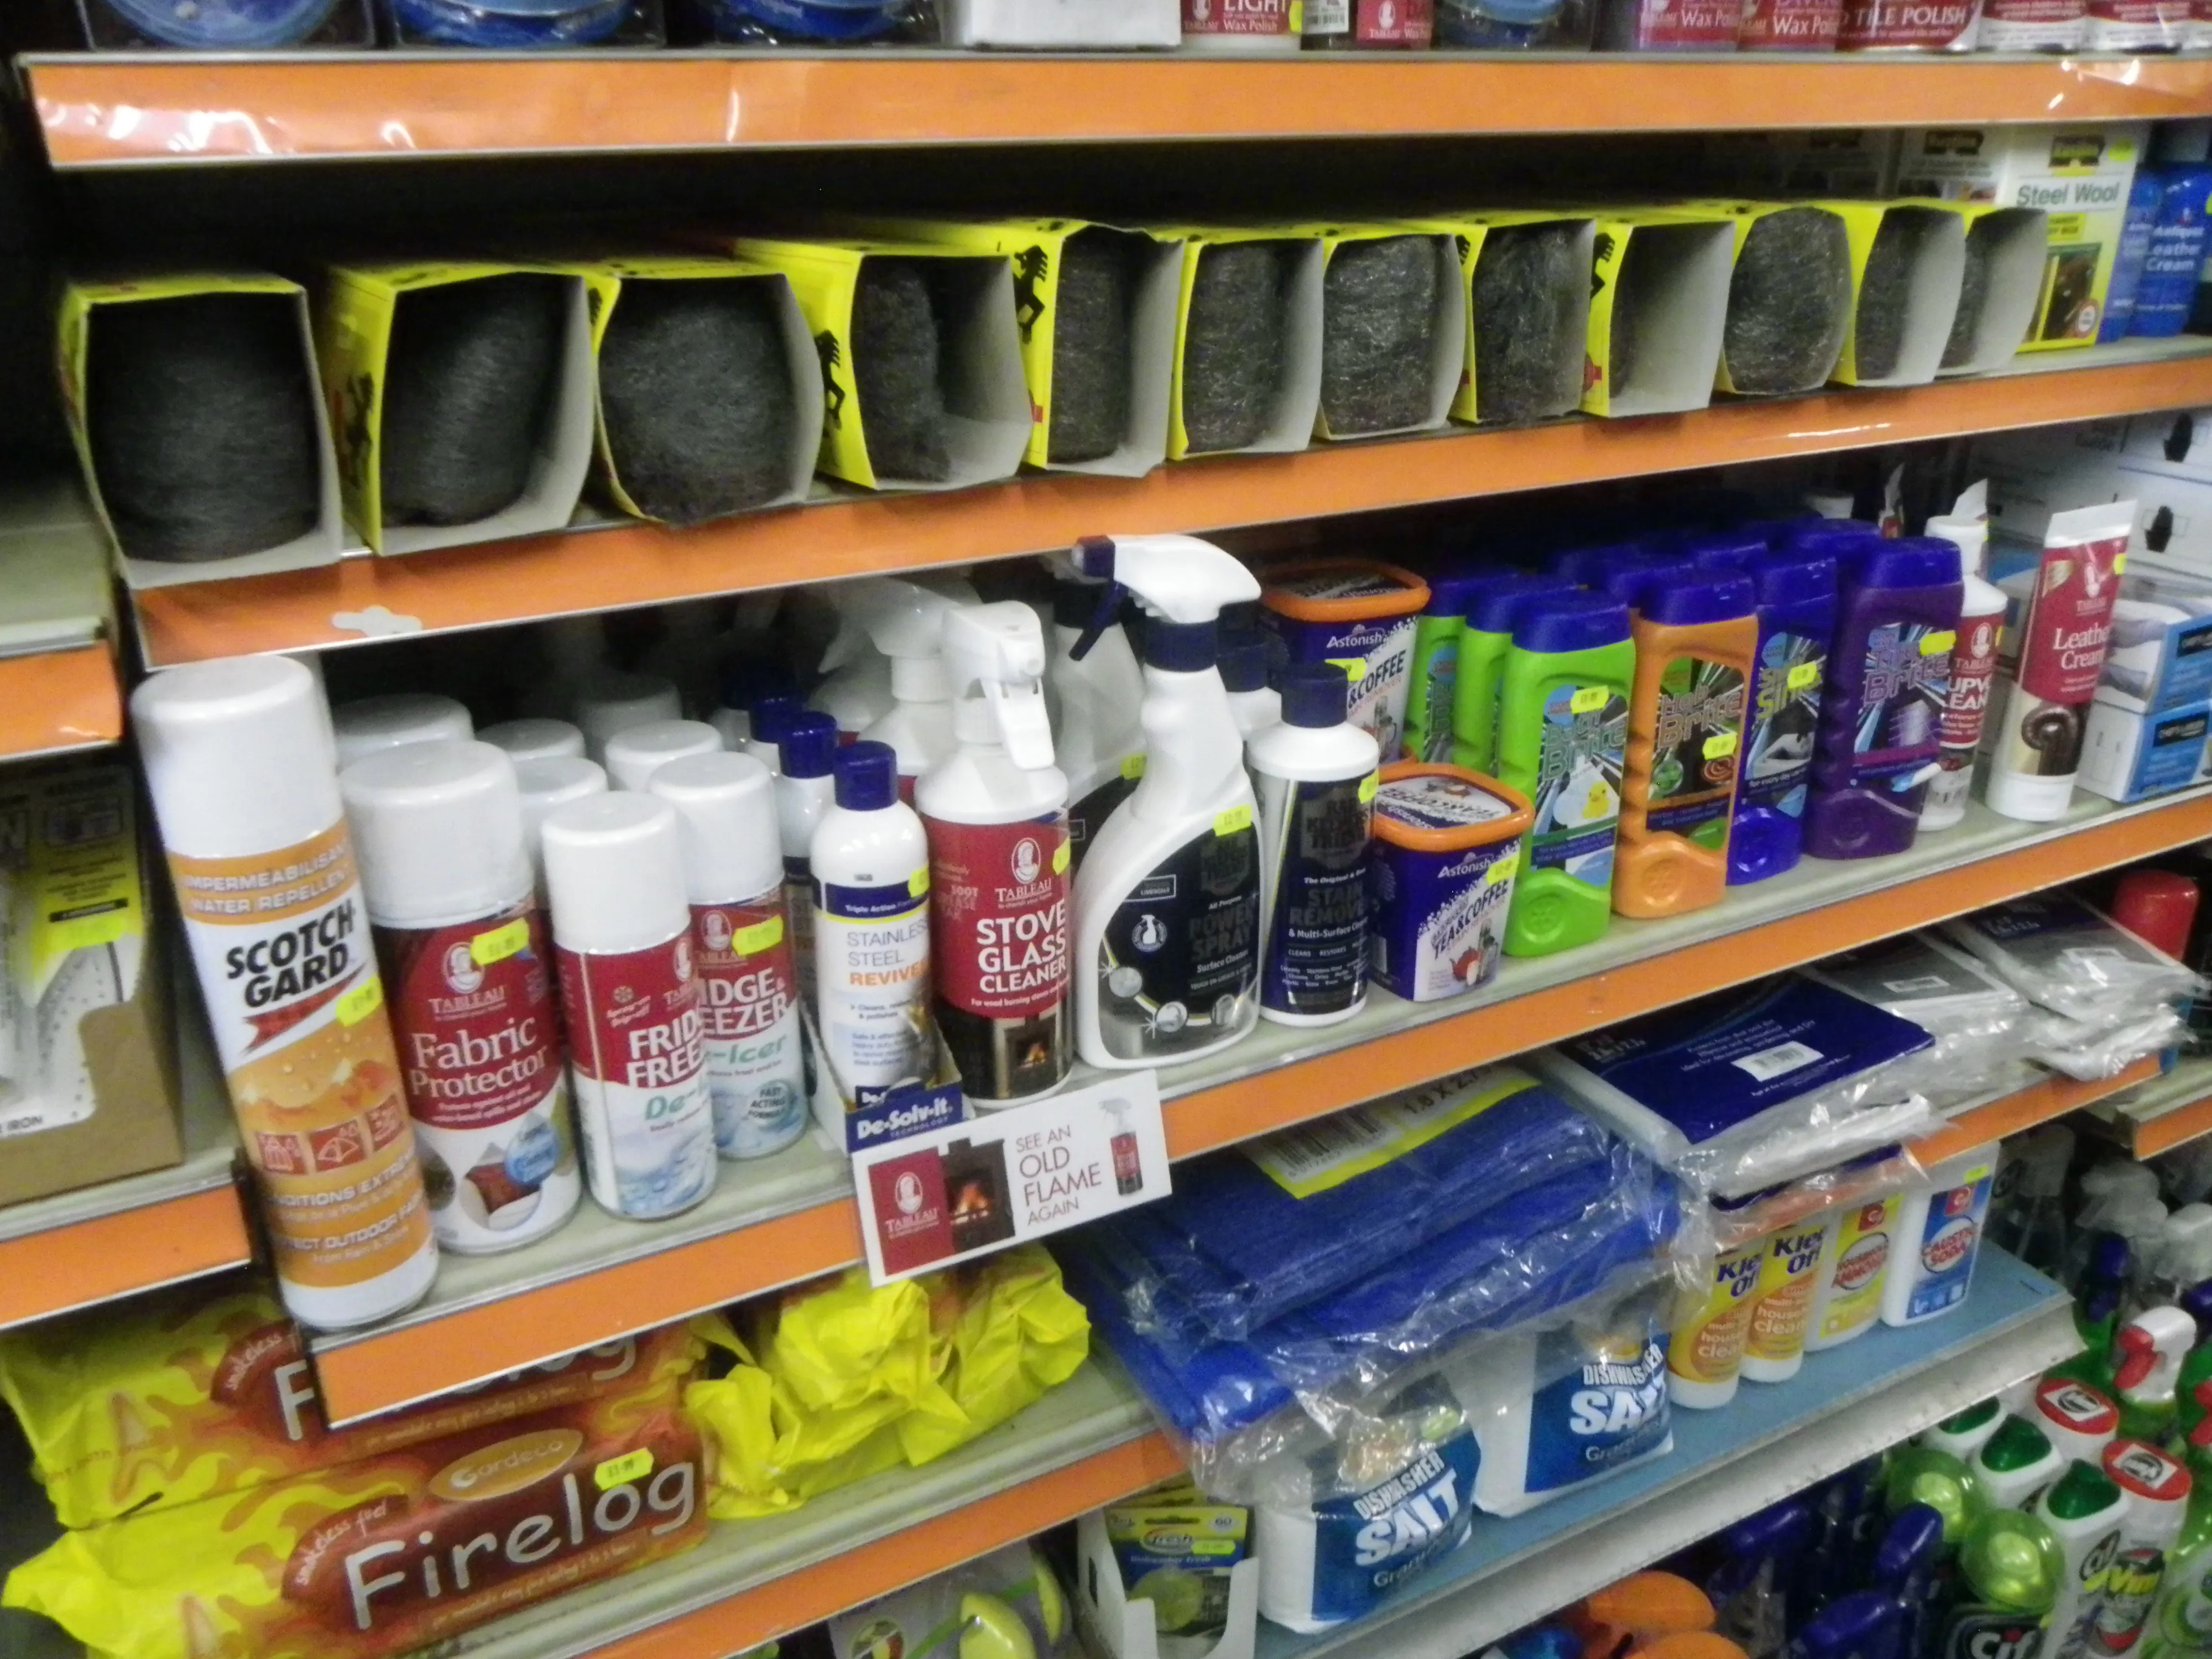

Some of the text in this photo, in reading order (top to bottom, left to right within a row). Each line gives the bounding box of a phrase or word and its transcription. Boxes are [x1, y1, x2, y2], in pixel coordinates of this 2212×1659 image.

[1224, 19, 1278, 32] Wax Polish
[1681, 9, 1711, 27] Wax
[1773, 15, 1809, 35] Wax
[1901, 6, 1968, 25] POLISH
[2016, 182, 2120, 207] Steel Wool
[1326, 631, 1383, 649] Astonish
[1660, 692, 1741, 748] Brite
[1542, 721, 1627, 780] Brite
[1437, 858, 1493, 879] Astonish
[191, 898, 252, 914] WATER
[995, 879, 1052, 902] TABLEAU
[226, 898, 355, 980] SCOTCH
[977, 898, 1066, 946] STOVE
[1288, 928, 1296, 938] &
[1297, 925, 1351, 939] Multi-Surface
[848, 950, 905, 967] STEEL
[978, 927, 1066, 973] GLASS
[1197, 958, 1224, 973] Surface
[243, 943, 348, 1008] GARD
[979, 954, 1066, 994] CLEANER
[411, 1016, 538, 1070] Fabric
[409, 1045, 548, 1099] Protector
[857, 1096, 948, 1140] De-Solv-it
[1015, 1124, 1071, 1153] SEE AN
[1019, 1146, 1070, 1178] OLD
[1024, 1162, 1102, 1207] FLAME
[886, 1208, 938, 1232] TABLEAU
[1027, 1196, 1079, 1226] AGAIN
[1583, 1343, 1663, 1386] DISHWASHER
[450, 1438, 565, 1488] Gardeco
[1353, 1449, 1445, 1520] DISHWASHER
[356, 1496, 387, 1537] fuel
[344, 1461, 695, 1631] Firelog
